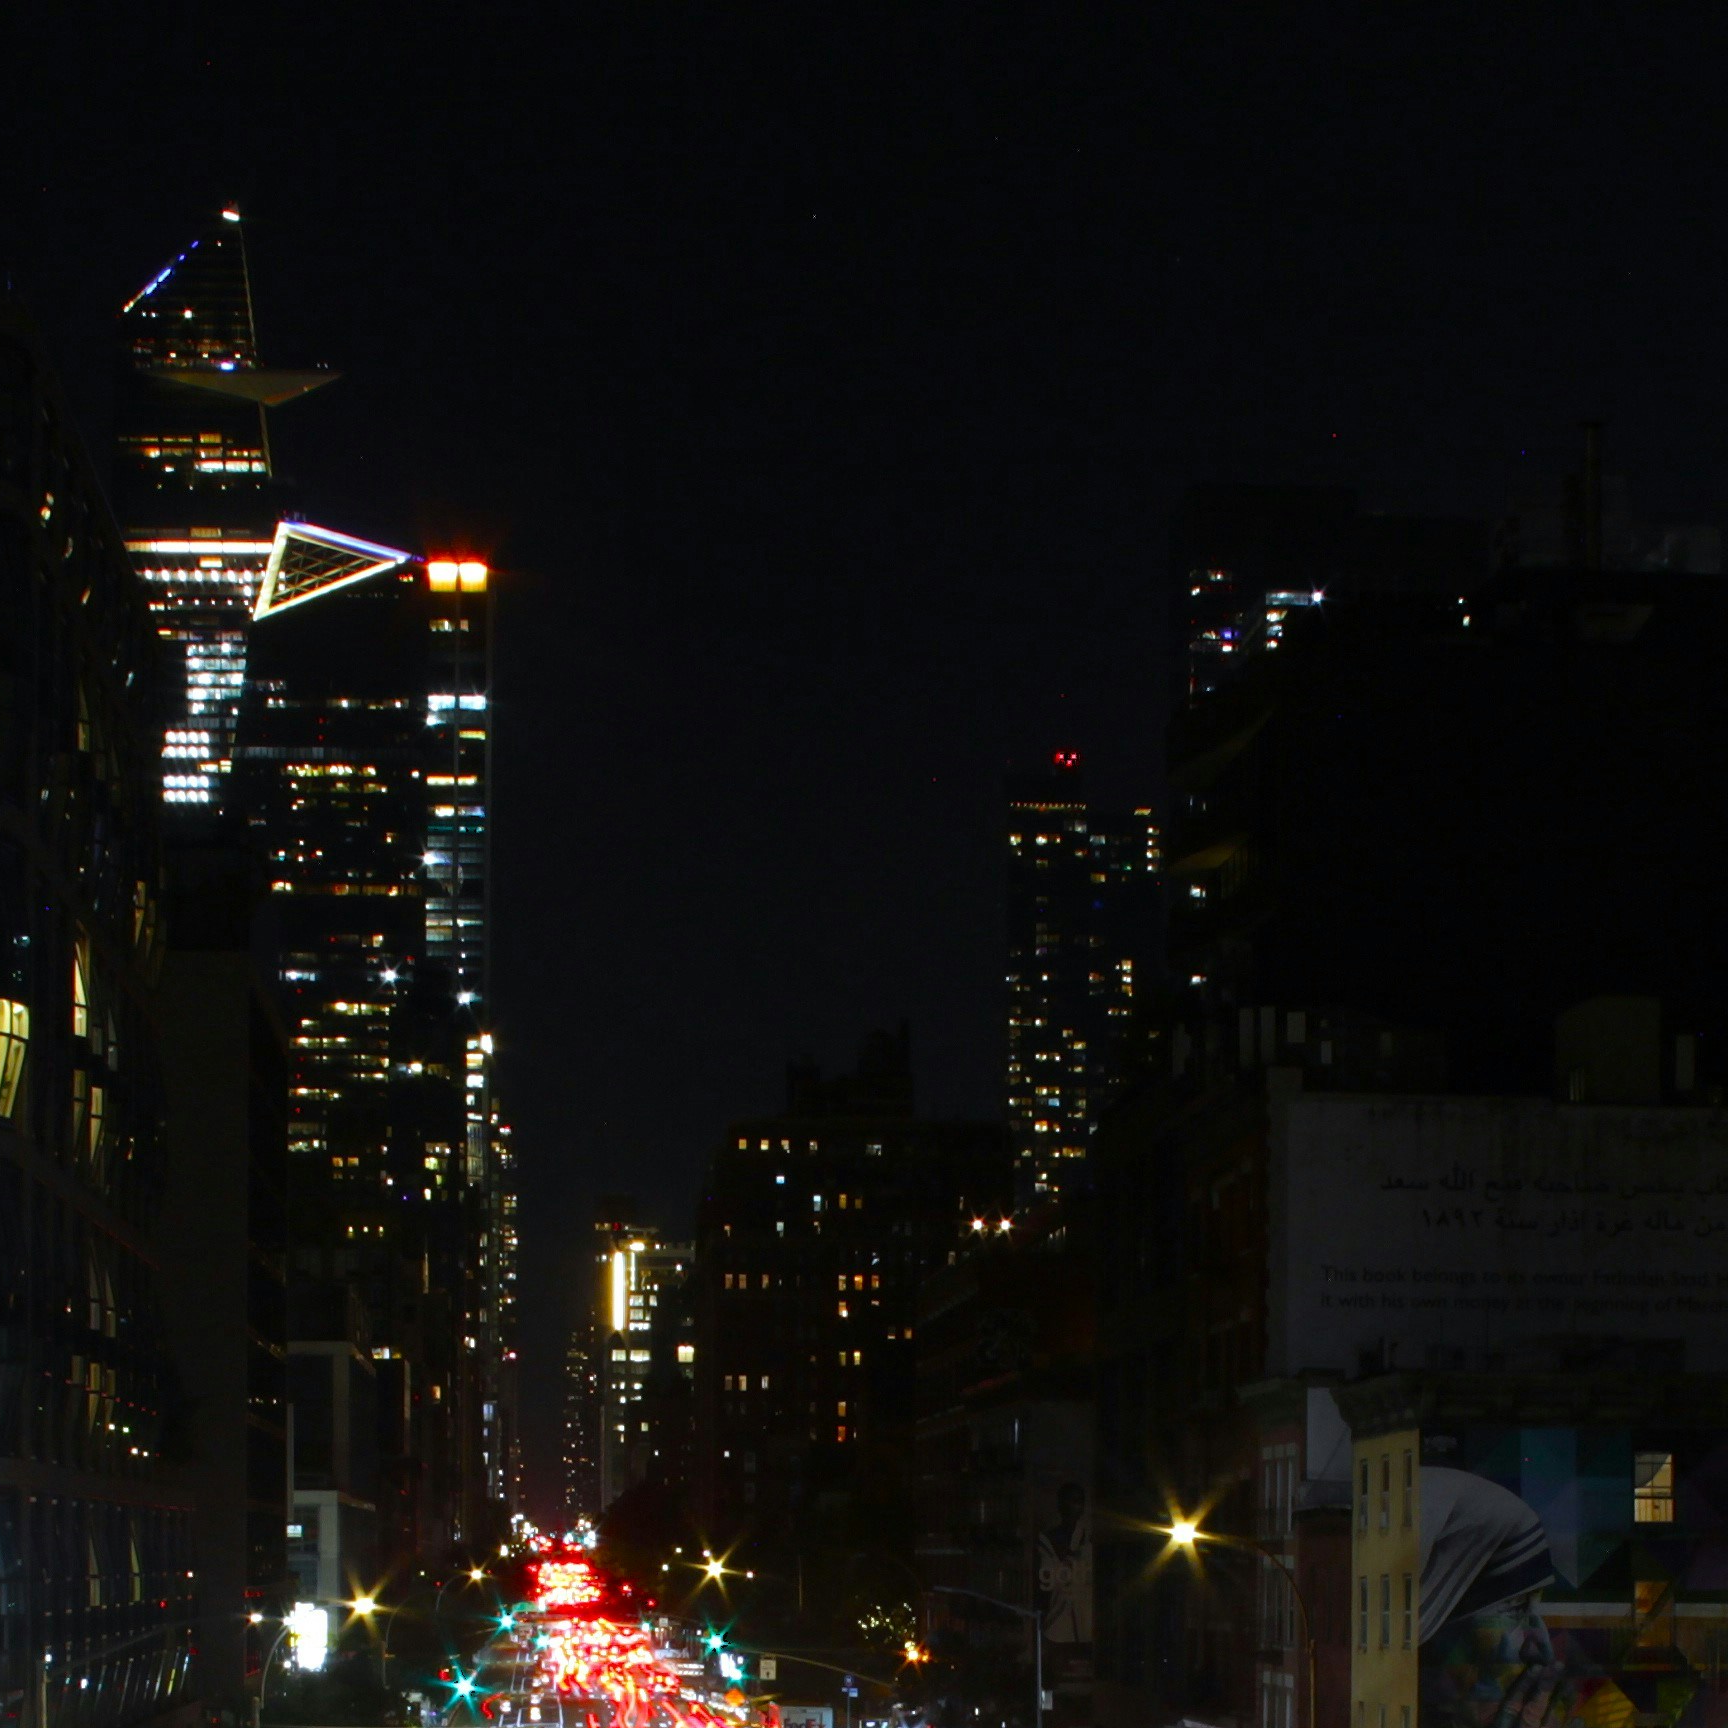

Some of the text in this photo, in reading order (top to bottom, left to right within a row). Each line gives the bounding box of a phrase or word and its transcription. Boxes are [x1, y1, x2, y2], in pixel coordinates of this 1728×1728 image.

[1320, 1264, 1357, 1283] This
[1362, 1266, 1405, 1283] book
[1412, 1266, 1477, 1288] belongs
[1481, 1270, 1502, 1284] to
[1532, 1271, 1585, 1286] owner
[1320, 1293, 1333, 1308] it
[1337, 1293, 1376, 1309] with
[1381, 1293, 1405, 1309] his
[1410, 1297, 1448, 1309] own
[1453, 1297, 1511, 1314] money
[1515, 1297, 1532, 1311] at
[1536, 1295, 1565, 1312] the
[1573, 1296, 1649, 1317] beginning
[1653, 1295, 1673, 1313] of
